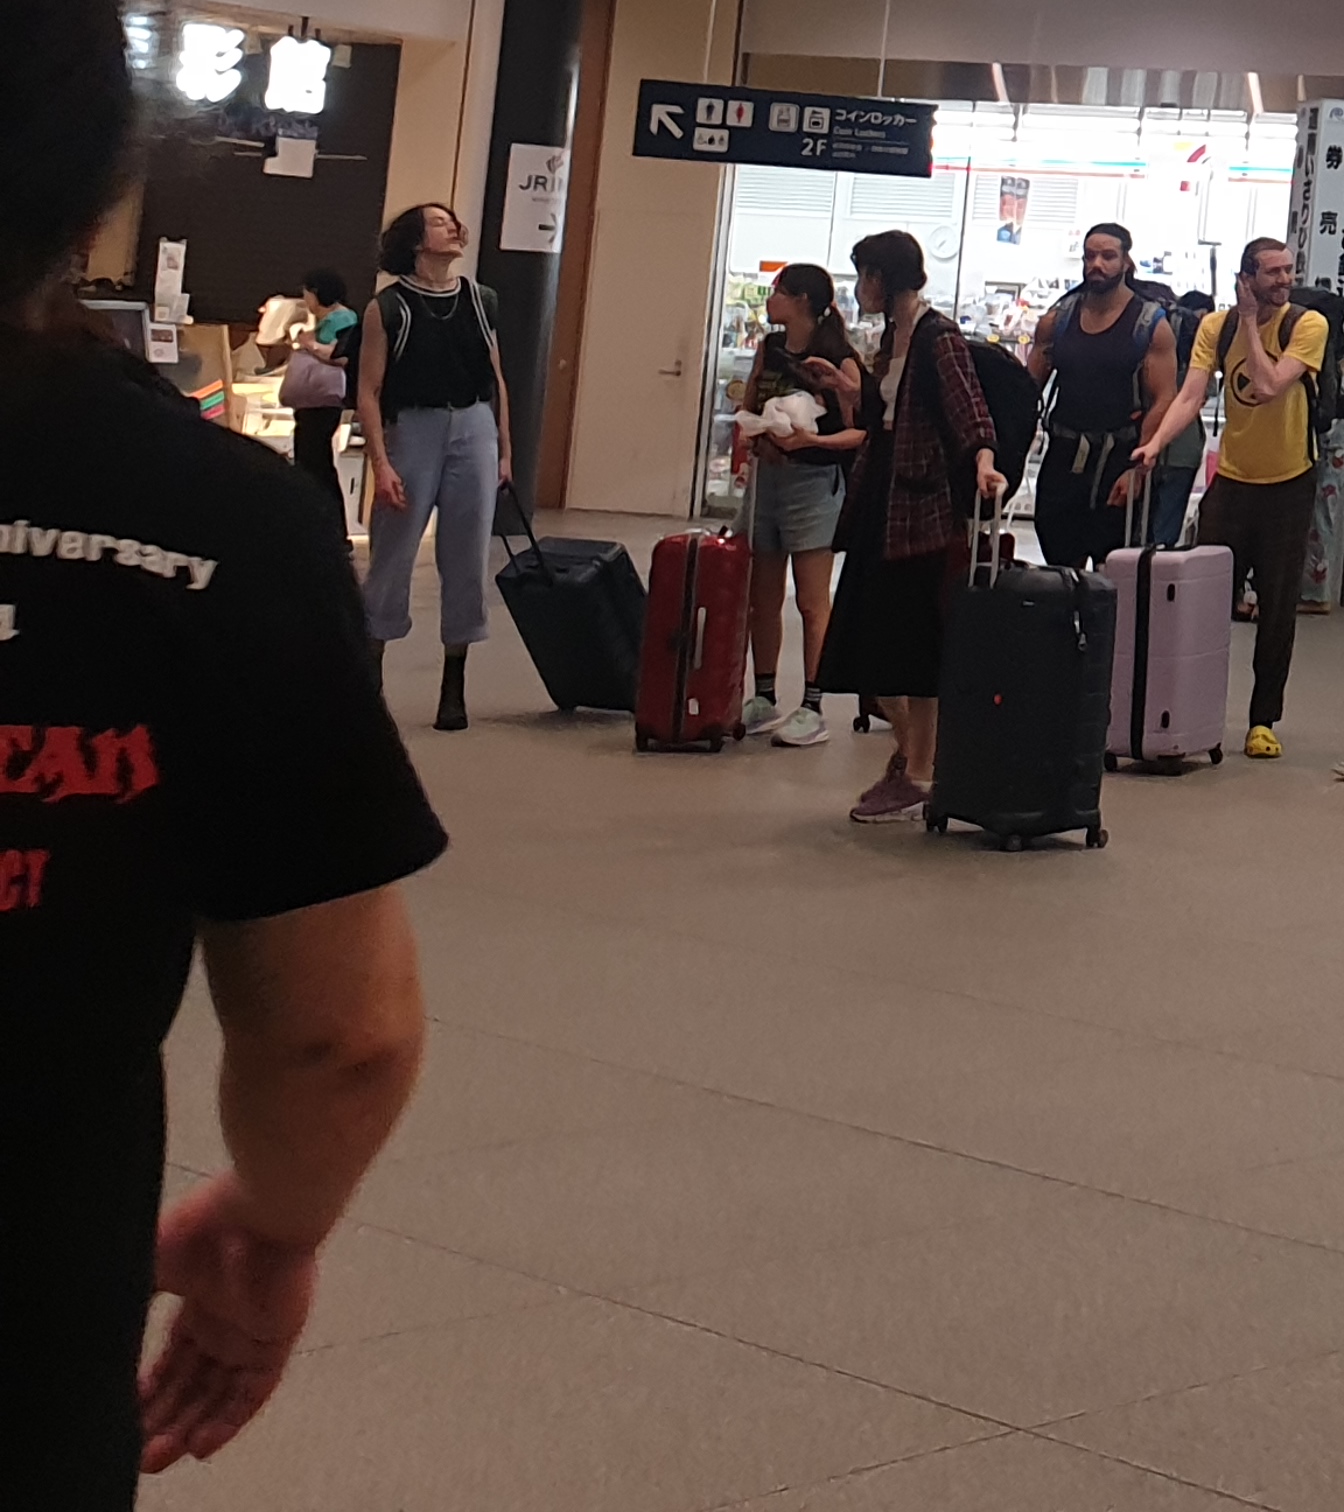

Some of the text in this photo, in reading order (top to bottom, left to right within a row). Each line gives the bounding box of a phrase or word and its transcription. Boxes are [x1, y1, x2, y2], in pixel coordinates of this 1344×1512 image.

[835, 109, 918, 127] コインロッカー
[801, 138, 827, 157] 2F
